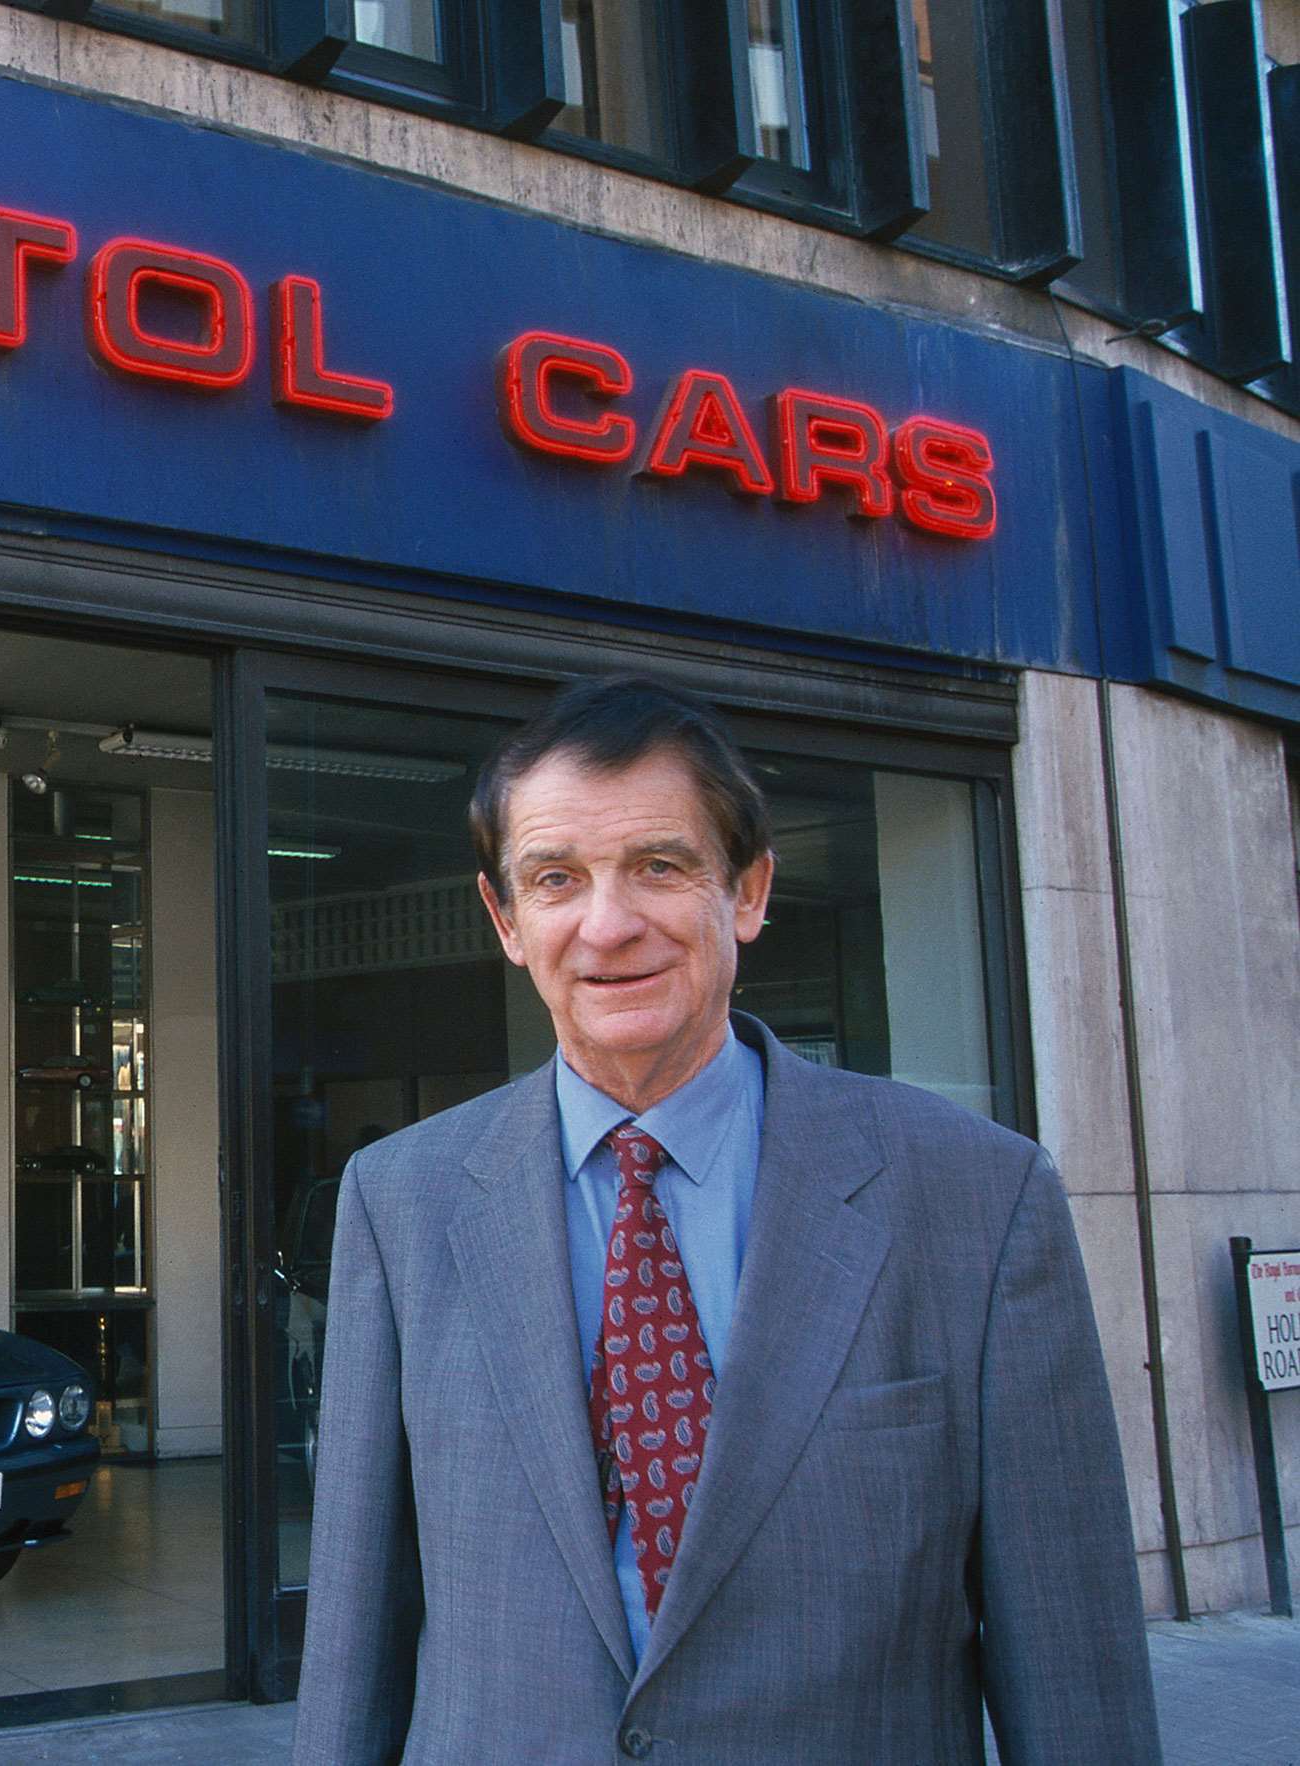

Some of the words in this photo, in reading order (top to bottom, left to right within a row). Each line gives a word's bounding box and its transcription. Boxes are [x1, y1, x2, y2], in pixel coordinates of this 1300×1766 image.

[502, 331, 997, 540] CARS
[1267, 1312, 1300, 1344] HOL
[1263, 1348, 1300, 1380] ROA
